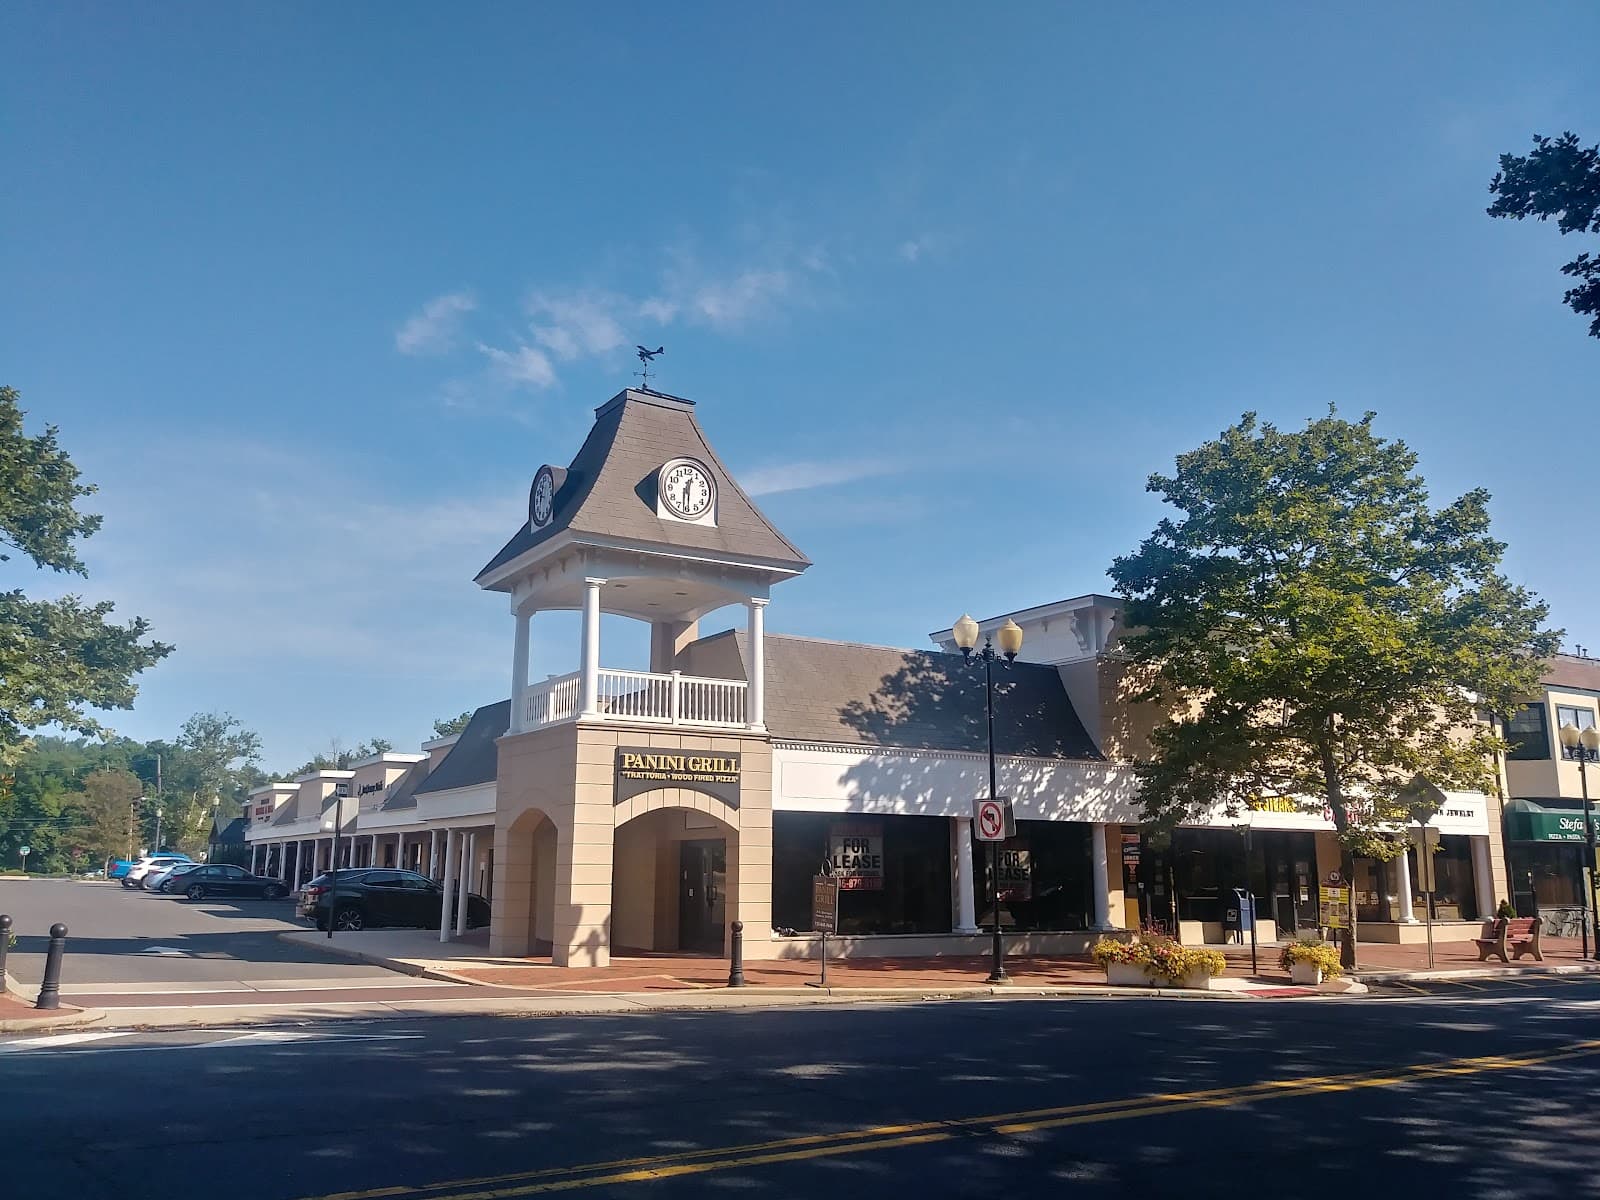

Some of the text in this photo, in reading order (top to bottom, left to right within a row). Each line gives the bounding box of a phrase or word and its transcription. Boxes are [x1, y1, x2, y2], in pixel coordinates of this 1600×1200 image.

[676, 469, 683, 478] 11
[684, 468, 693, 476] 12
[668, 484, 673, 492] 9
[622, 752, 740, 773] PANINI GRILL
[671, 773, 693, 781] WOOD
[694, 774, 714, 782] FIRED
[1560, 818, 1600, 831] Stefa's
[844, 838, 870, 854] FOR
[834, 856, 880, 868] LEASE
